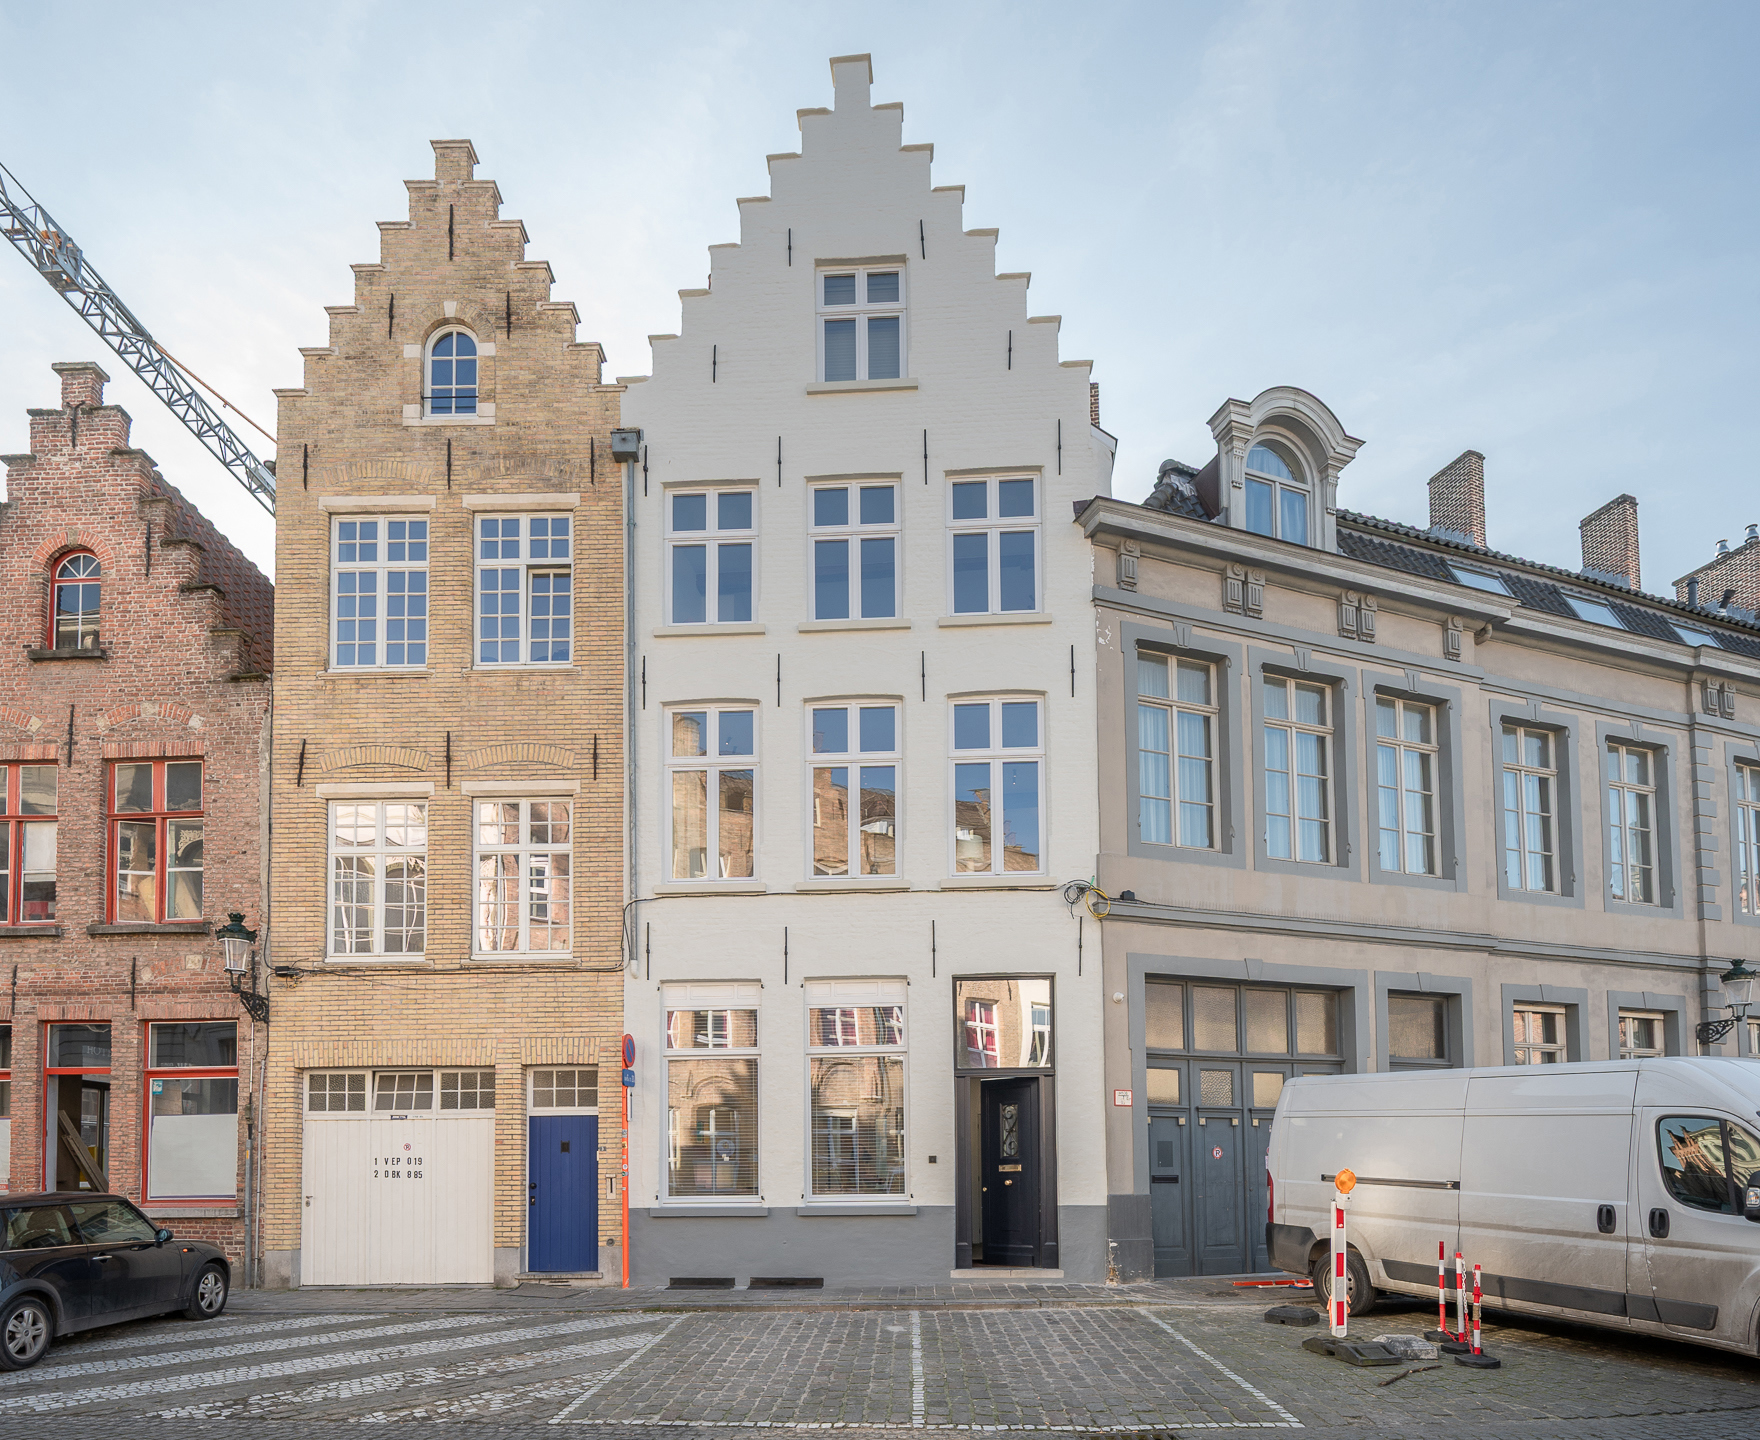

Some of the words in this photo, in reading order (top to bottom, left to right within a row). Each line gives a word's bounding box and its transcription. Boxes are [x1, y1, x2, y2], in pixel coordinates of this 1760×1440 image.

[384, 1157, 401, 1166] VEP
[406, 1156, 423, 1166] 019
[373, 1169, 379, 1179] 2
[406, 1170, 423, 1179] 885
